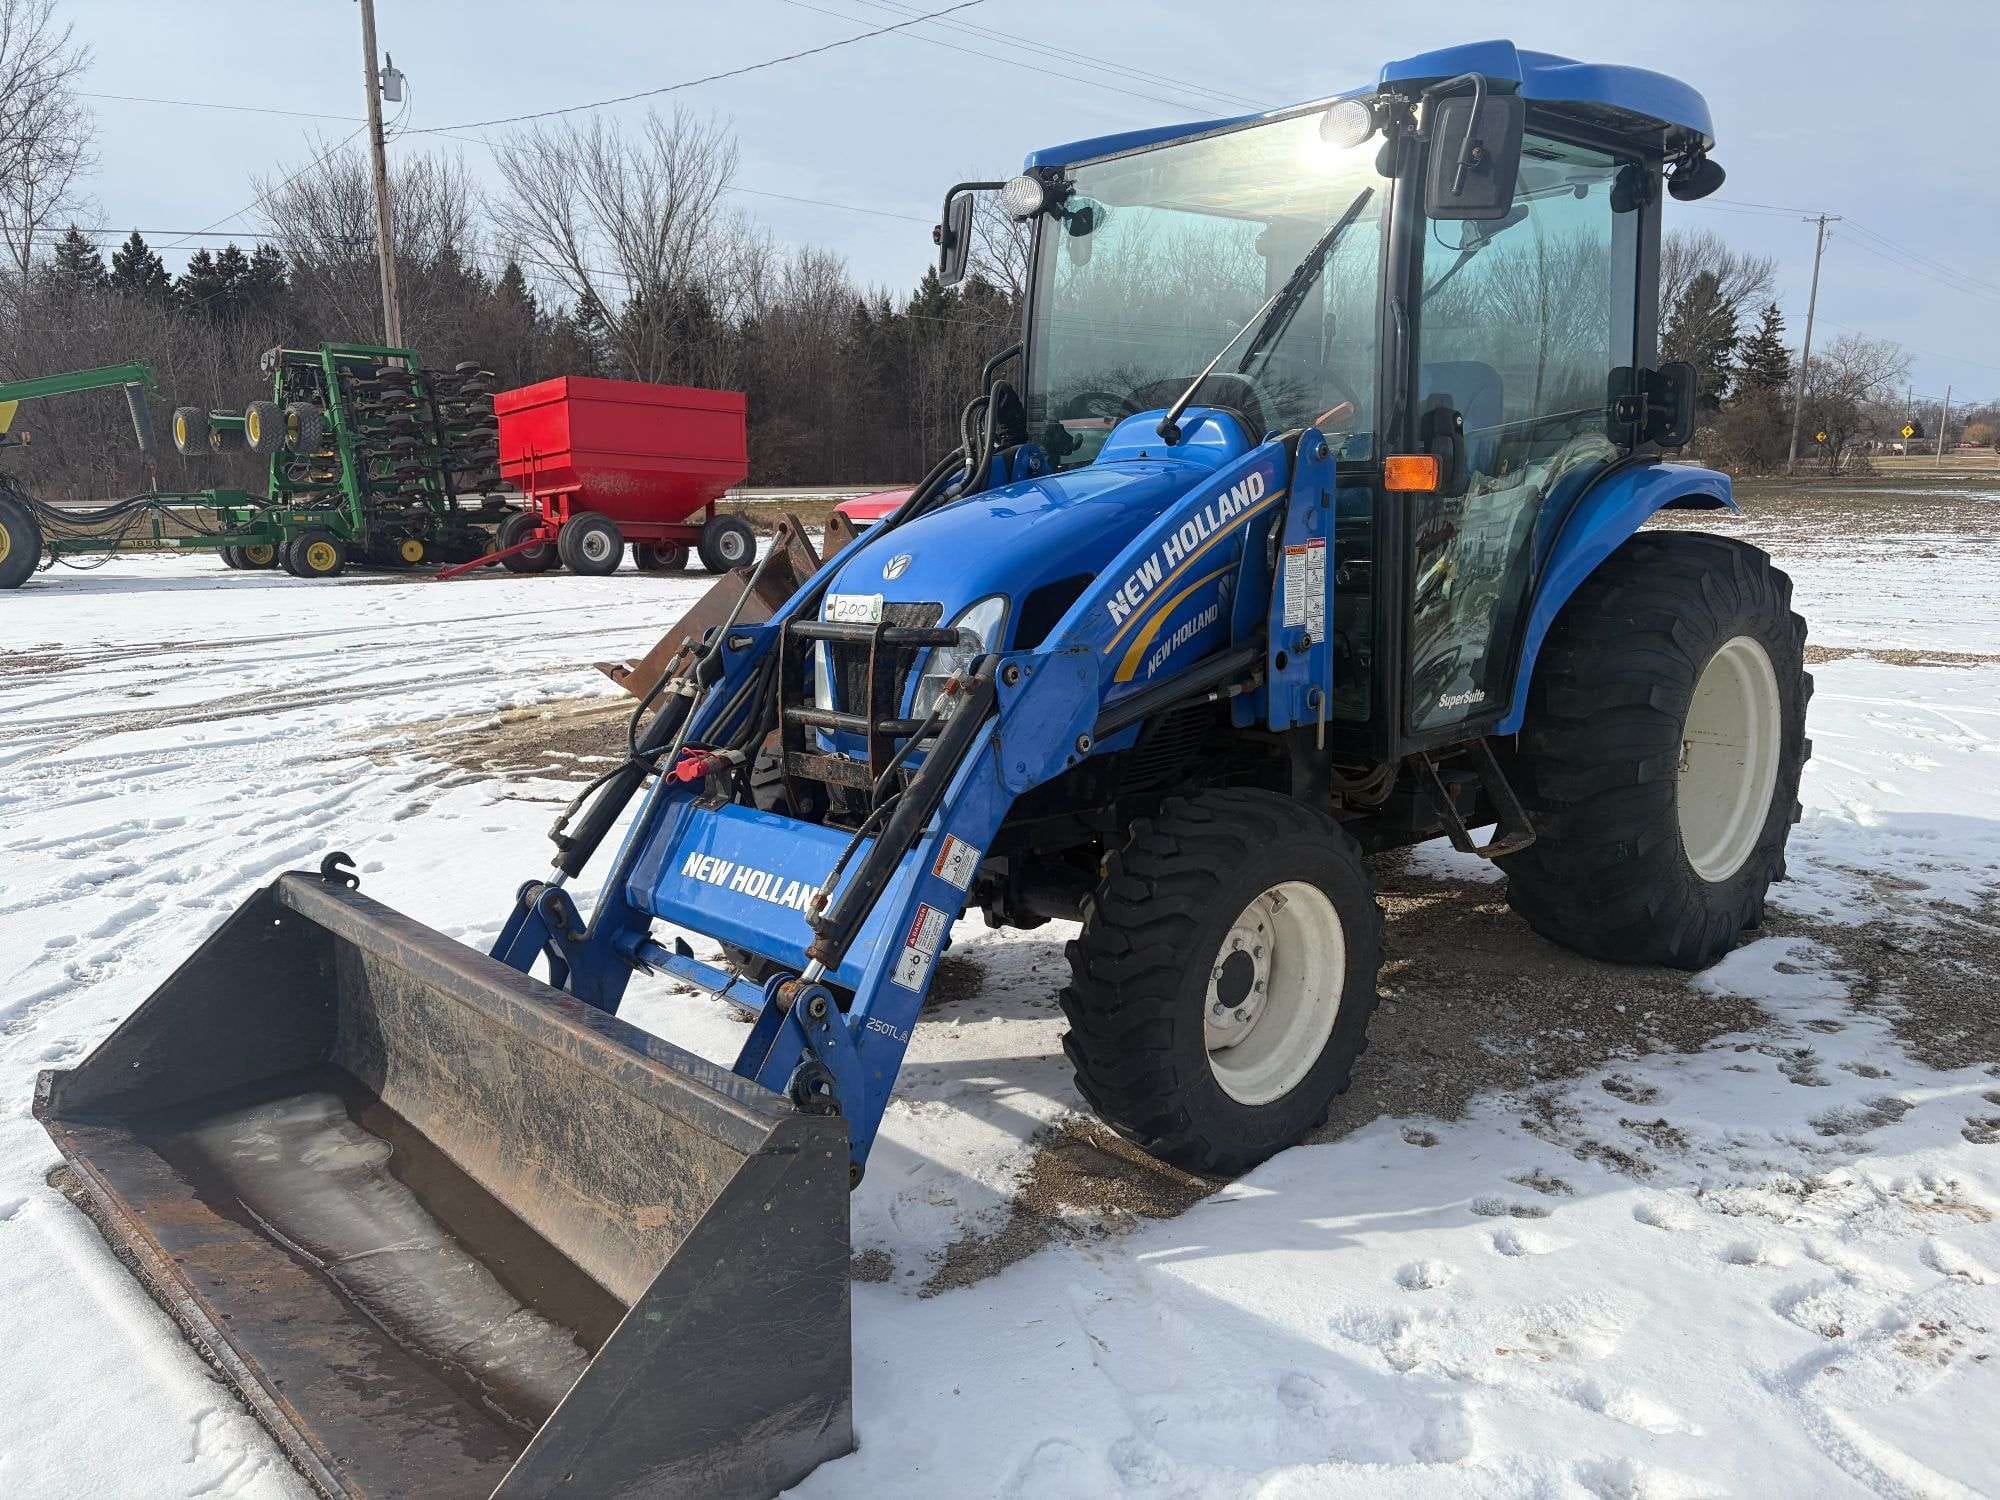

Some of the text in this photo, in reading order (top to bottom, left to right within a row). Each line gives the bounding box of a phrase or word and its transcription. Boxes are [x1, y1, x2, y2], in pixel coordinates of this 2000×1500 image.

[1106, 471, 1265, 626] NEW HOLLAND
[1147, 604, 1219, 679] NEW HOLLAND
[1438, 688, 1485, 709] SuperSuite
[681, 851, 734, 887] NEW
